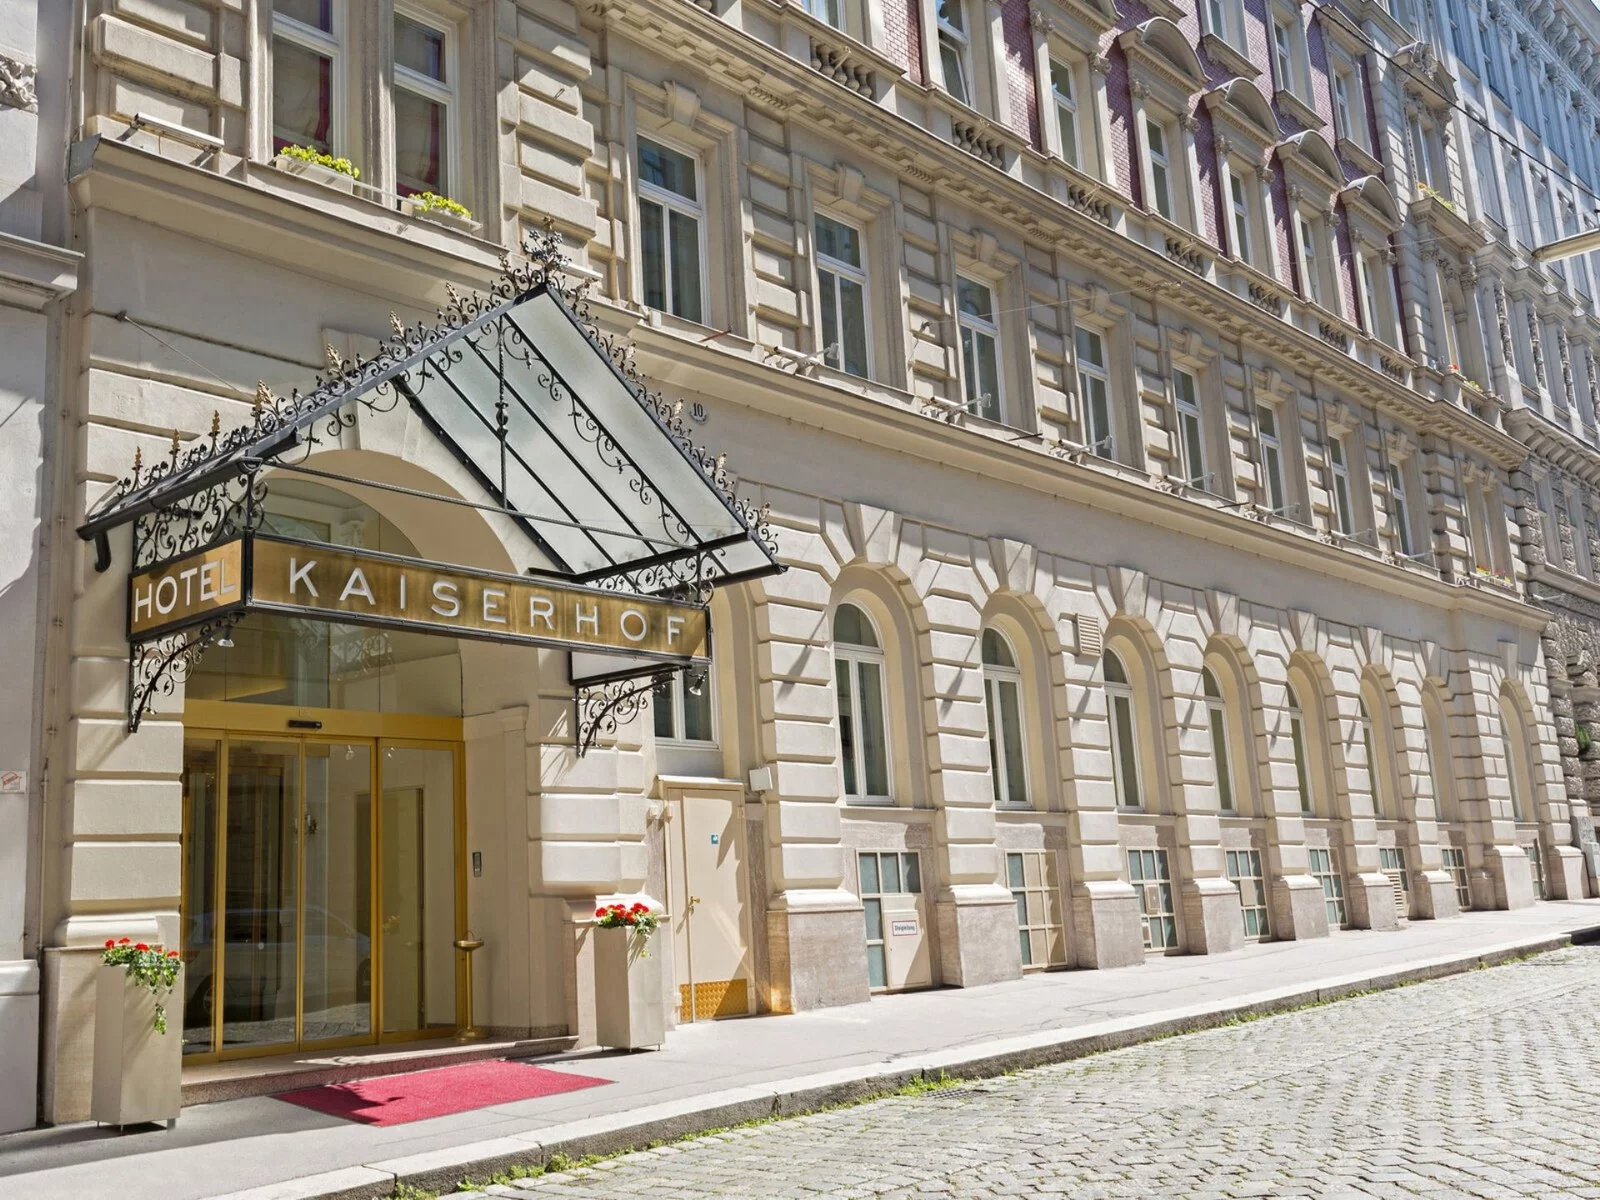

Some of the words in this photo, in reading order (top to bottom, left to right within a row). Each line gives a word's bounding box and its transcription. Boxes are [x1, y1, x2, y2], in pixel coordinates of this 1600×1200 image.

[693, 402, 704, 418] 10
[134, 558, 236, 623] HOTEL
[289, 557, 685, 645] KAISERHOF
